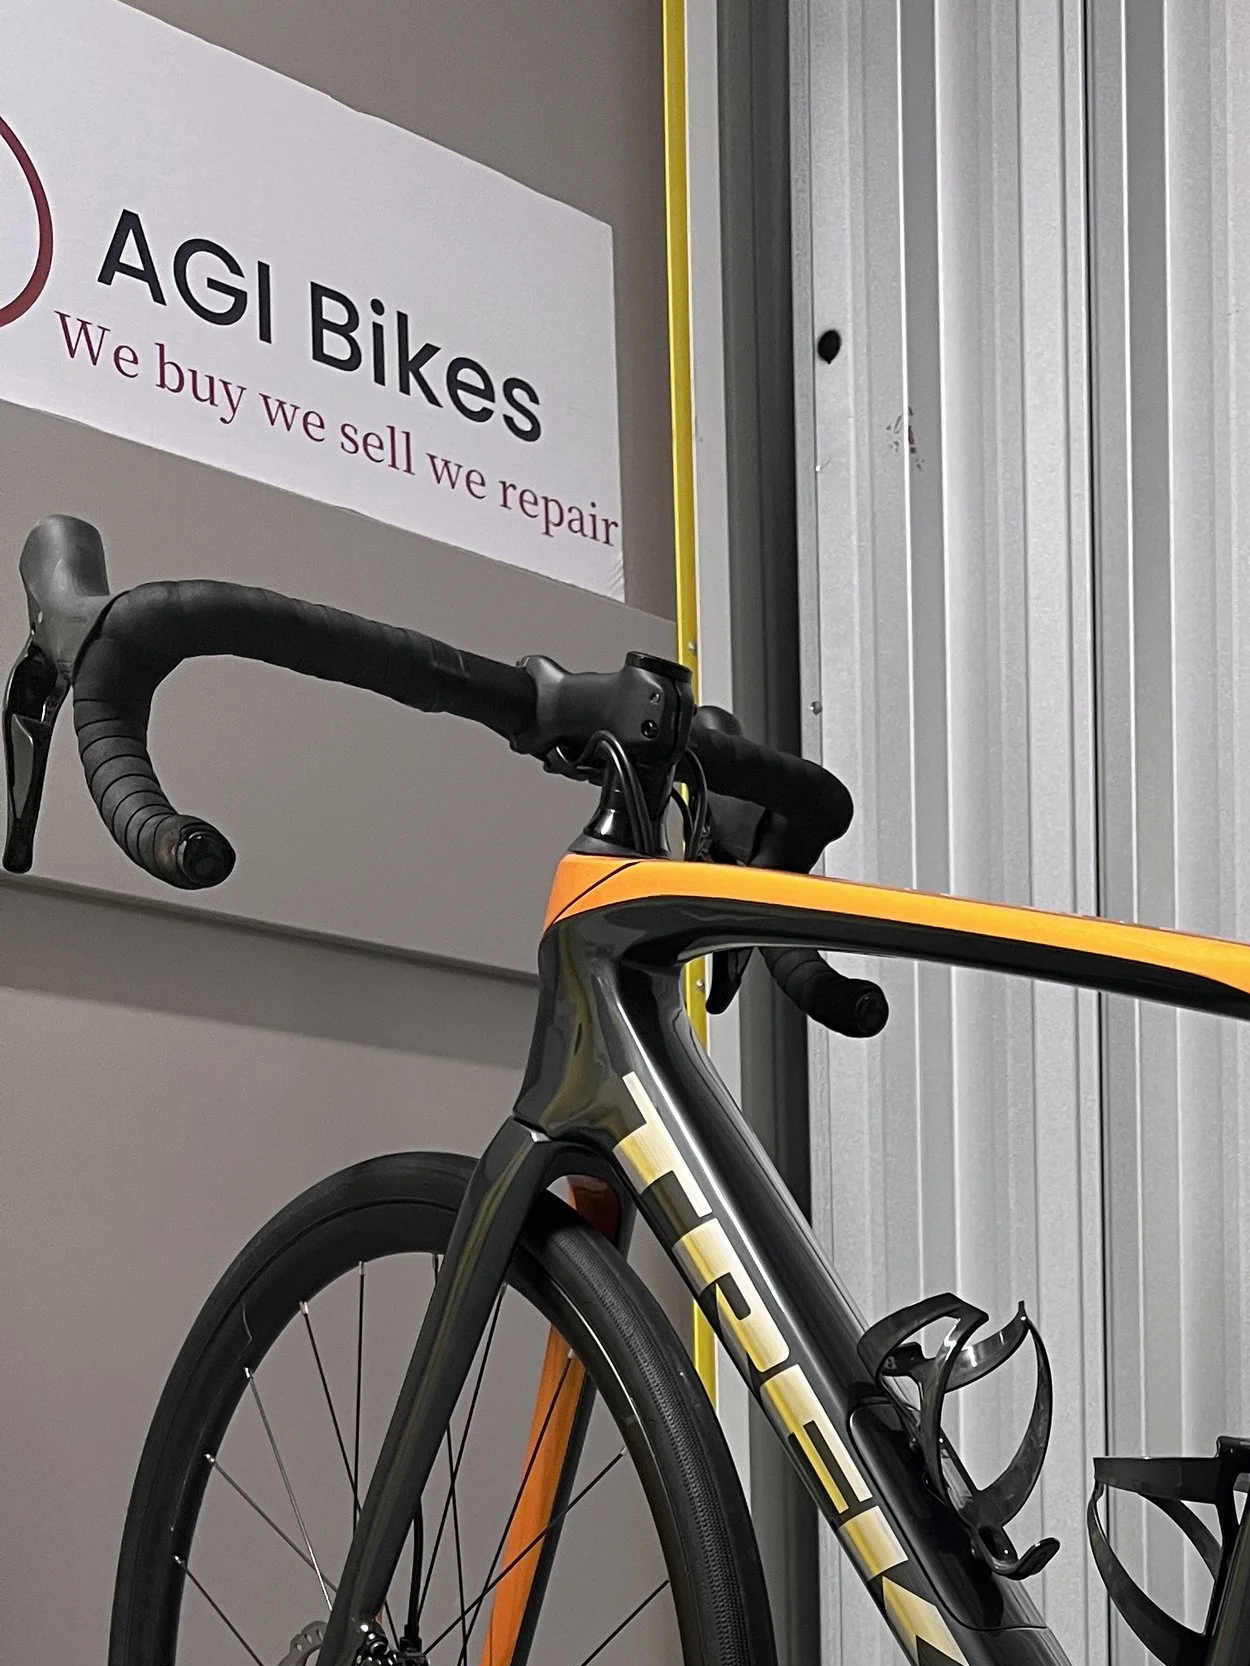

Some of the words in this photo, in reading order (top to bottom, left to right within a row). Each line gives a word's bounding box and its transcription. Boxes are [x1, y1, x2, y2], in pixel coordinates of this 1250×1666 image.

[54, 310, 139, 379] We
[155, 341, 249, 426] buy
[258, 392, 327, 443] we
[340, 424, 416, 476] sell
[425, 453, 487, 499] we
[499, 477, 619, 547] repair
[97, 208, 273, 344] AGI
[310, 280, 542, 443] Bikes
